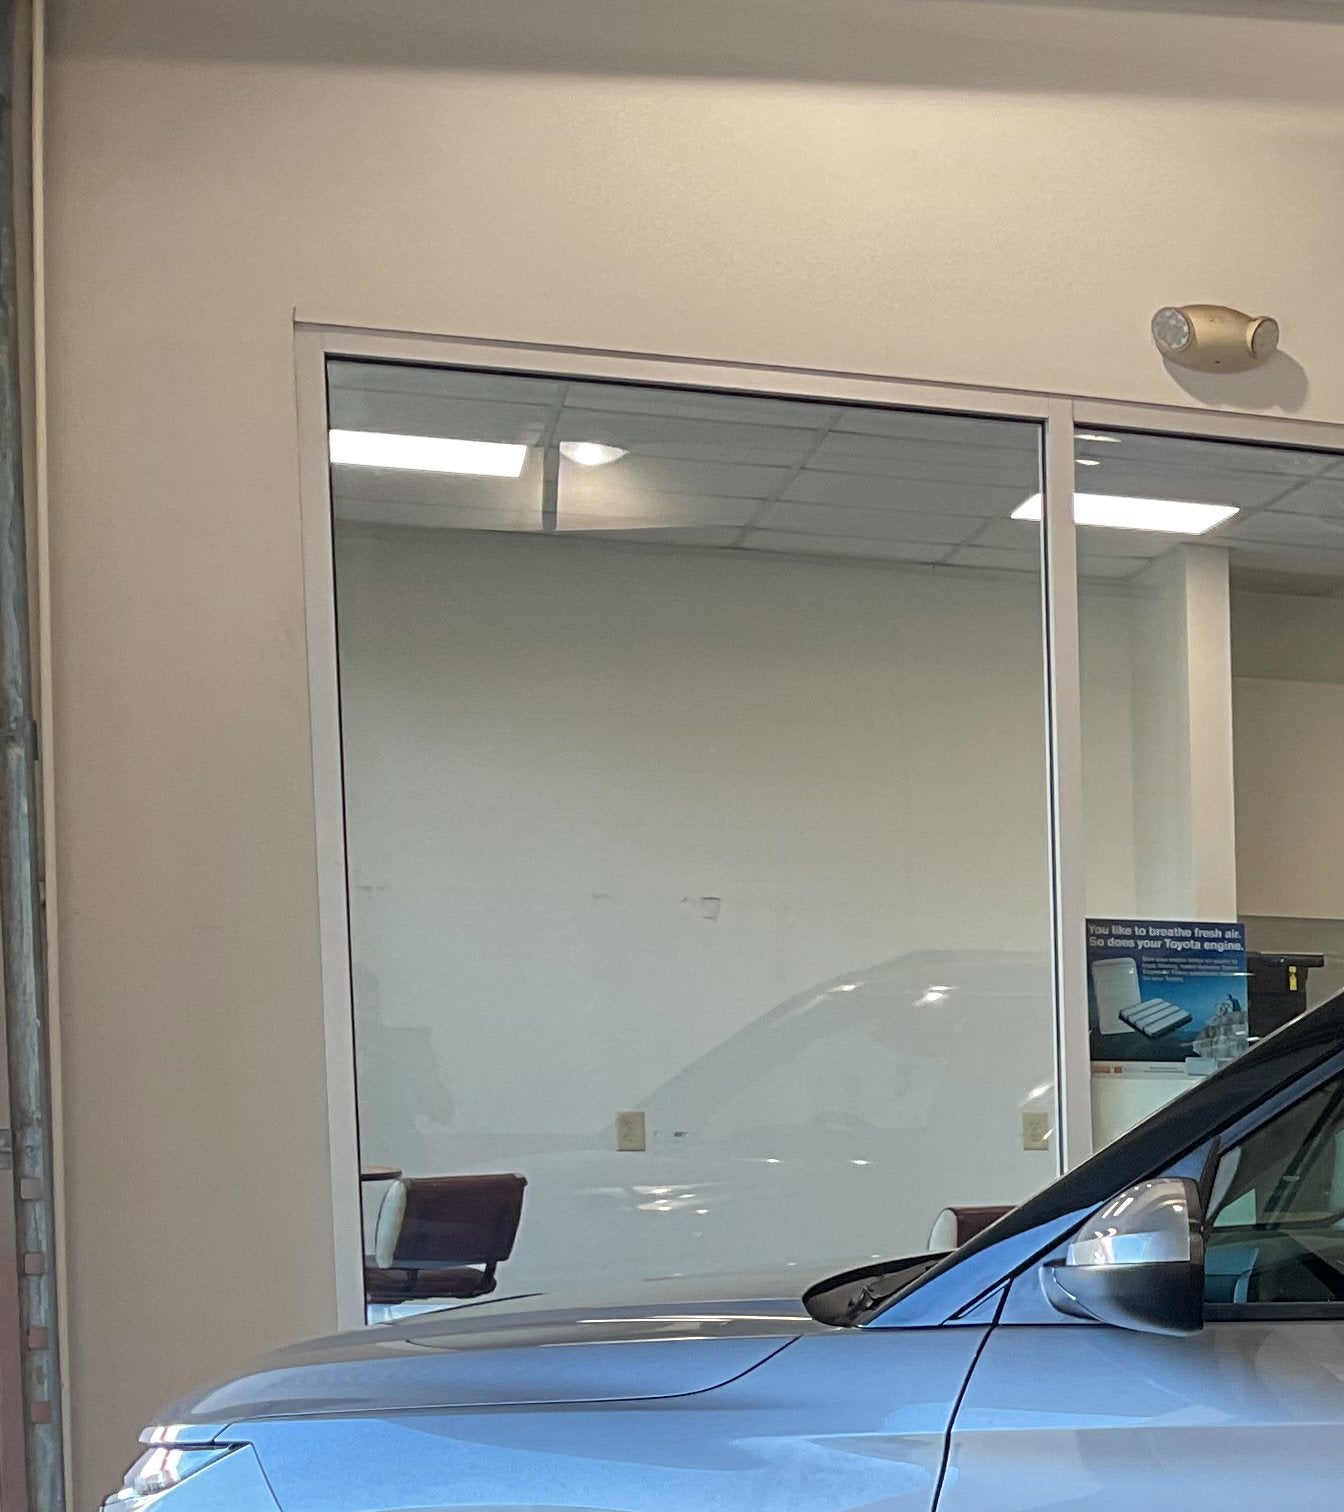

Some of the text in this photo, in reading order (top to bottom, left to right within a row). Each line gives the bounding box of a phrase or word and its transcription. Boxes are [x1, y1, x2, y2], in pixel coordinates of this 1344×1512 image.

[1088, 925, 1241, 939] You like to breathe fresh air.
[1089, 936, 1244, 952] So does your Toyota engine.
